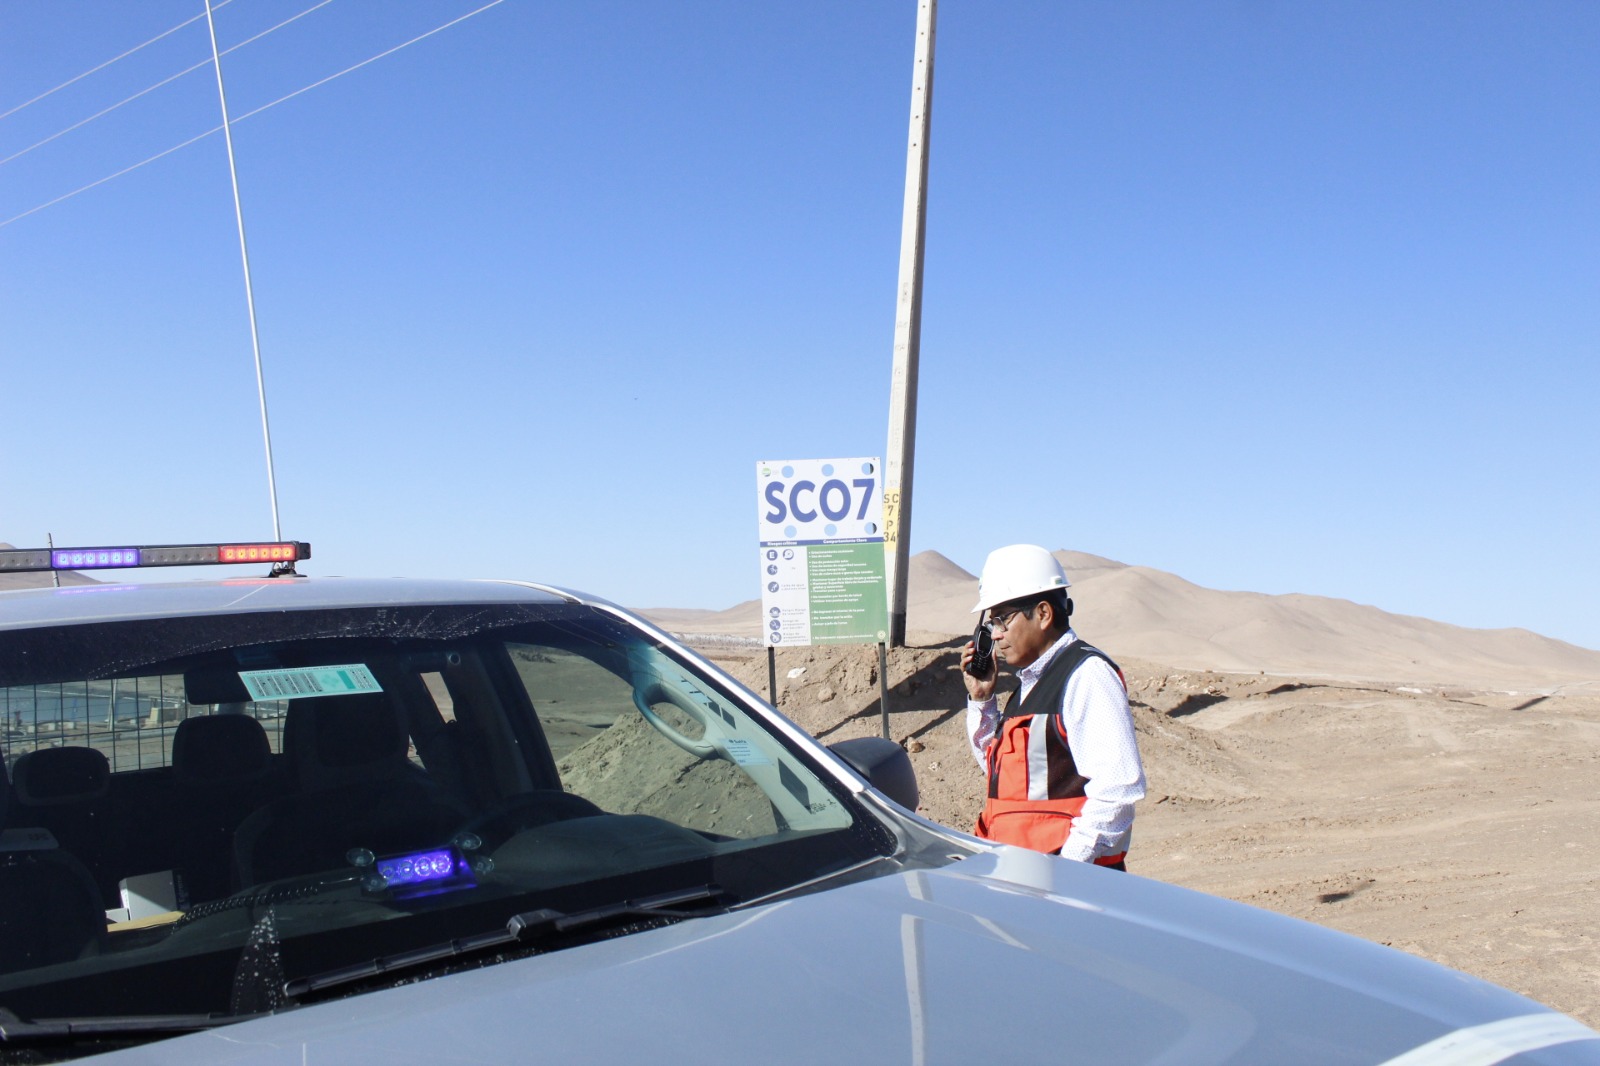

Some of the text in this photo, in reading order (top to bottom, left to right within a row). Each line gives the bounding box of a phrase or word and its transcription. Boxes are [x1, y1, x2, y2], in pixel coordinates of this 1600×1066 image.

[883, 493, 899, 504] SC
[887, 505, 894, 516] 7
[886, 520, 894, 530] P
[883, 531, 896, 543] 34
